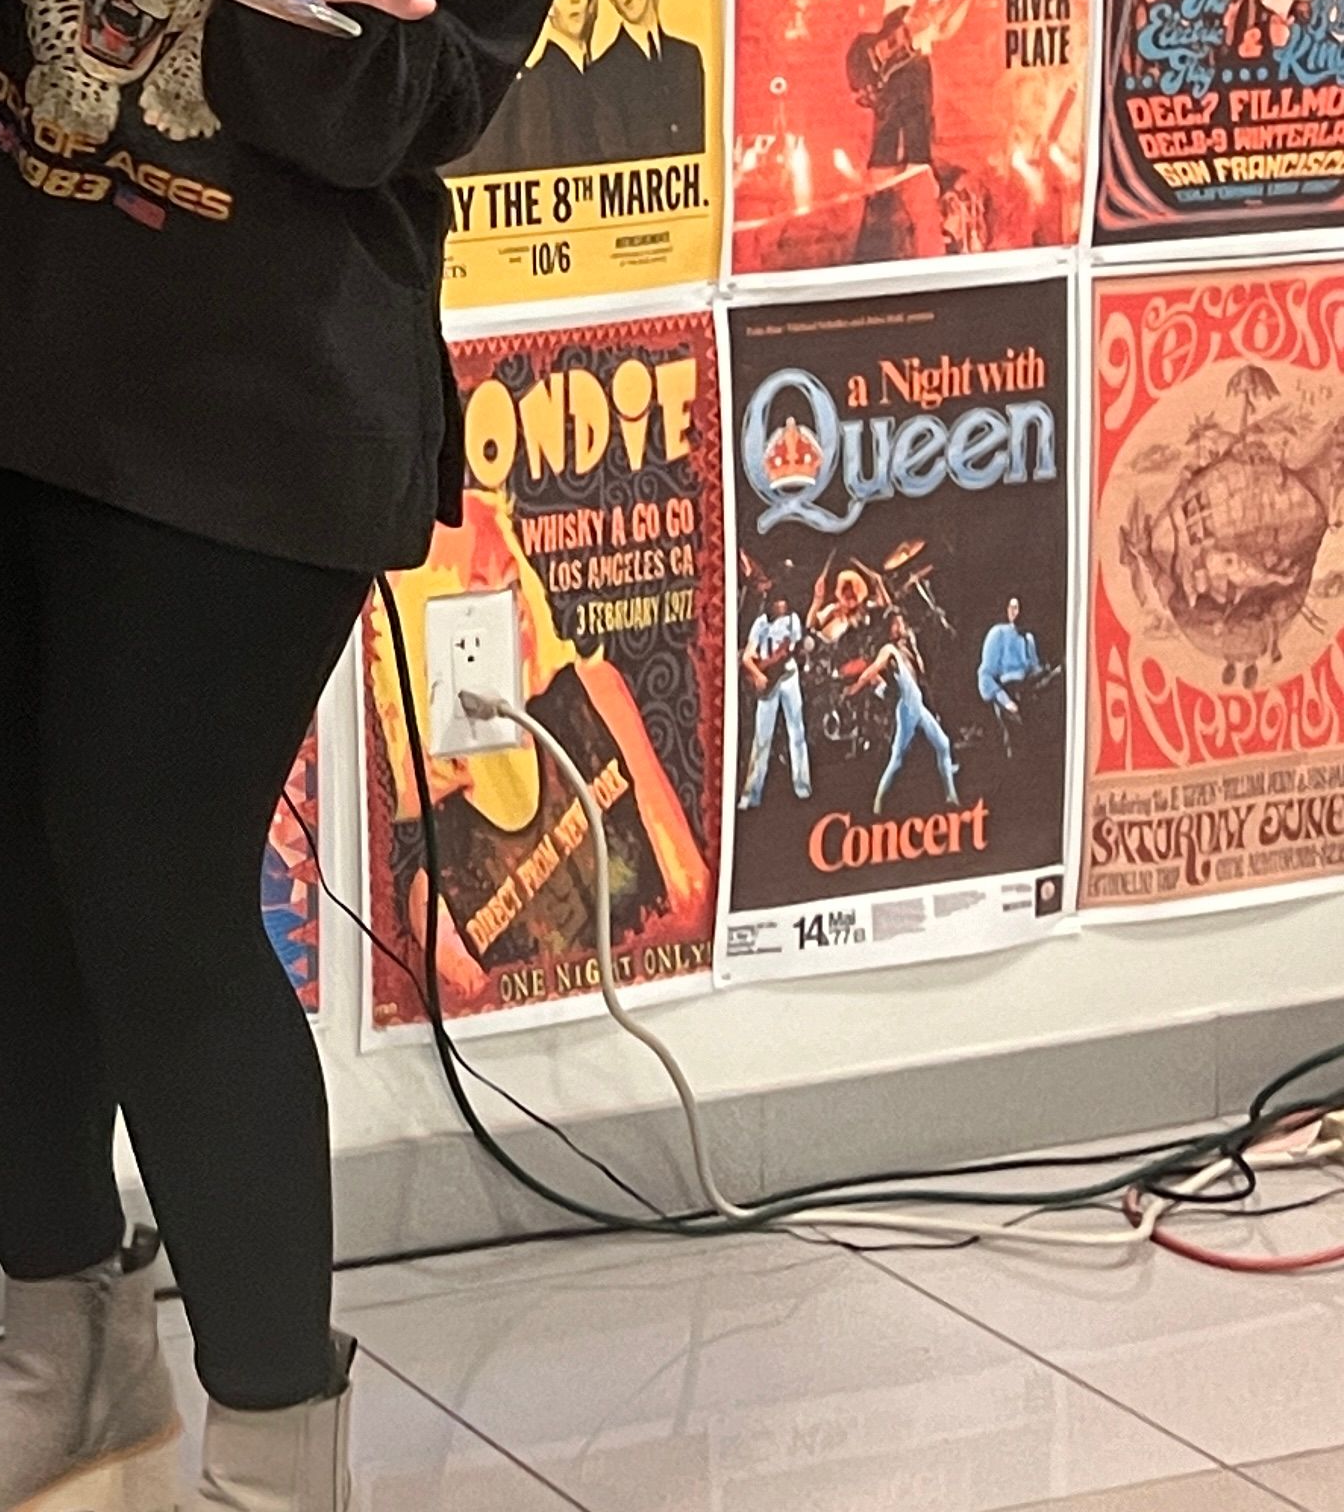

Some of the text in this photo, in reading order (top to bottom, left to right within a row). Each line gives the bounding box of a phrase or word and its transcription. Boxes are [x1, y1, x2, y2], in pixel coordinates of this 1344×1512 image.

[1005, 25, 1071, 69] PLATE
[33, 120, 97, 159] OF
[483, 180, 543, 229] THE
[599, 162, 710, 219] MARCH.
[1153, 159, 1211, 188] SAN
[532, 240, 571, 276] 10/6
[847, 346, 1045, 410] a Night with
[742, 367, 1058, 535] Queen
[521, 498, 694, 557] WHISKY A GO GO
[549, 543, 694, 593] LOS ANGELES CA
[576, 589, 694, 635] 3 FEBRUARY 1977
[808, 796, 990, 873] Concert
[1091, 803, 1255, 886] SATURDAY
[1258, 793, 1344, 846] JUNE
[465, 876, 524, 957] DIRECT
[515, 833, 561, 901] FROM
[500, 969, 546, 1002] ONE
